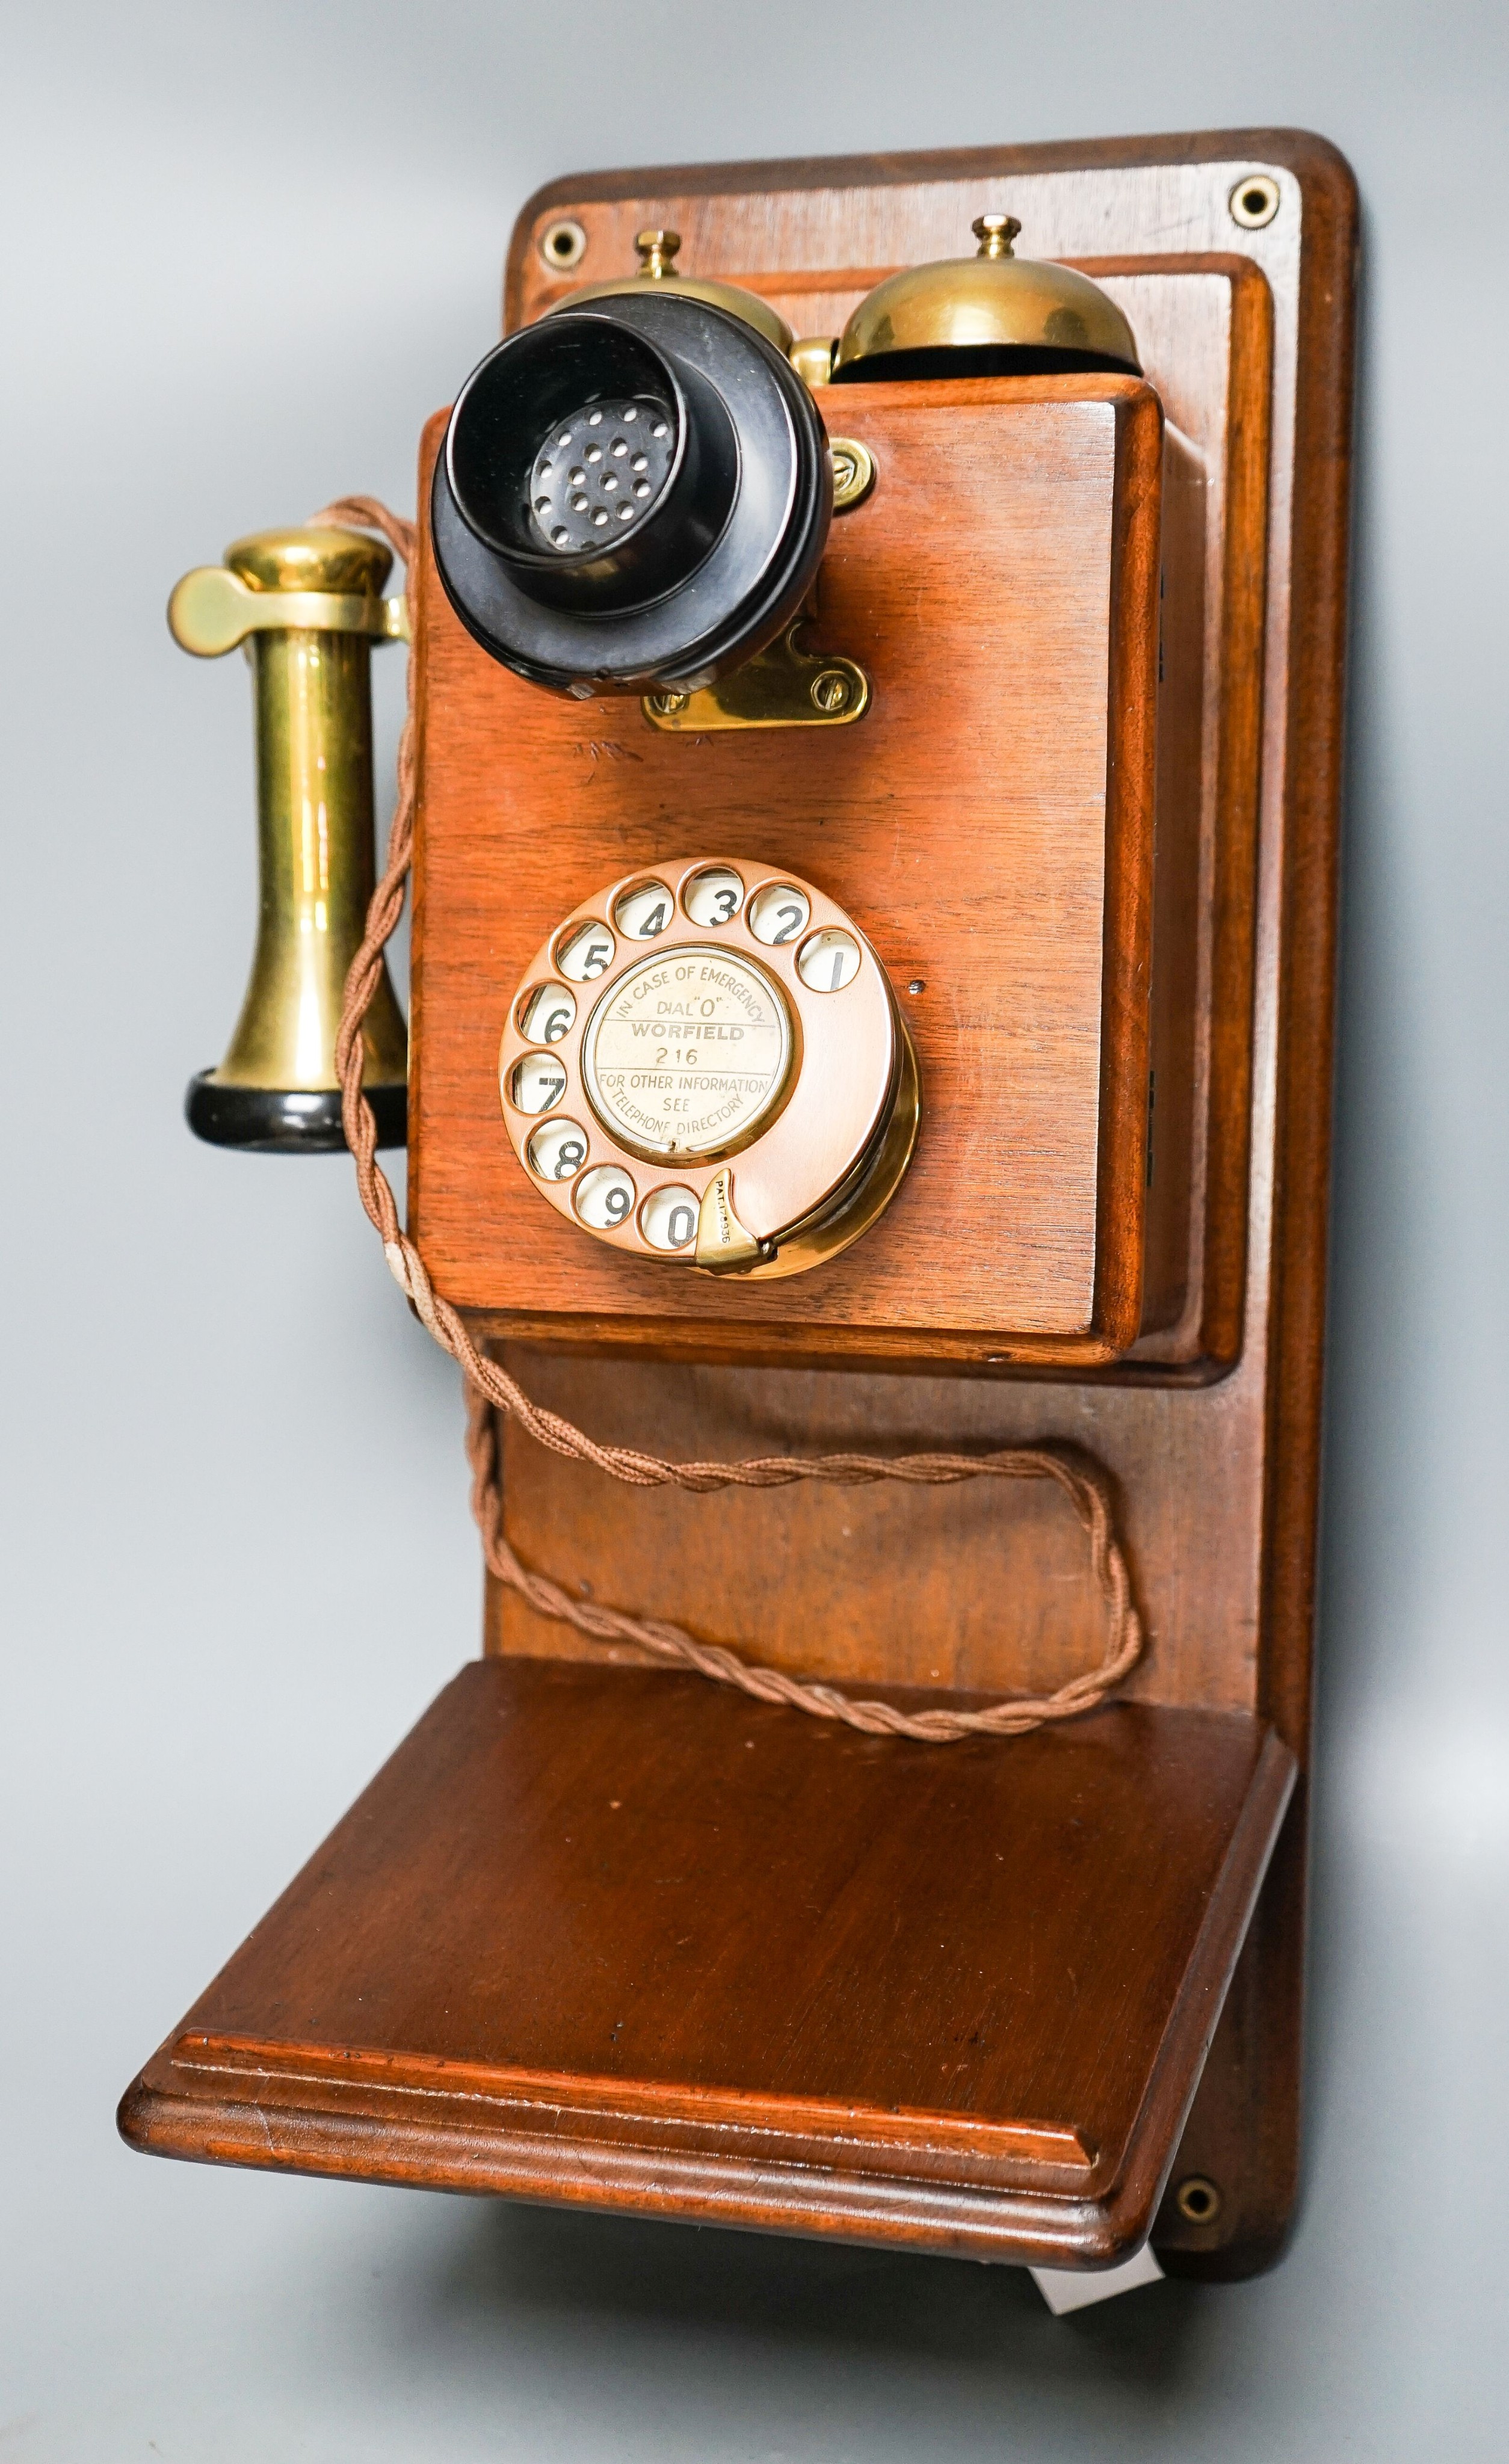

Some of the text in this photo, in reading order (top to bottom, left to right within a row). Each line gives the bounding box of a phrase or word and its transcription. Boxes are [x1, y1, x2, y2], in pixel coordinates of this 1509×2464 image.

[639, 903, 665, 936] 4
[709, 889, 737, 926] 3
[773, 905, 803, 944] 2
[582, 944, 609, 981] 5
[830, 952, 844, 991] 1
[616, 966, 765, 1022] IN CASE OF EMERGENCY
[657, 1002, 694, 1015] DIAL
[545, 1009, 570, 1043] 6
[632, 1023, 744, 1040] WORFIELD
[656, 1047, 697, 1065] 216
[538, 1077, 564, 1112] 7
[600, 1074, 768, 1093] FOR OTHER INFORMATION
[611, 1088, 744, 1135] TELEPHONE DIRECTORY
[663, 1098, 690, 1112] SEE
[554, 1141, 584, 1179] 8
[604, 1187, 630, 1227] 9
